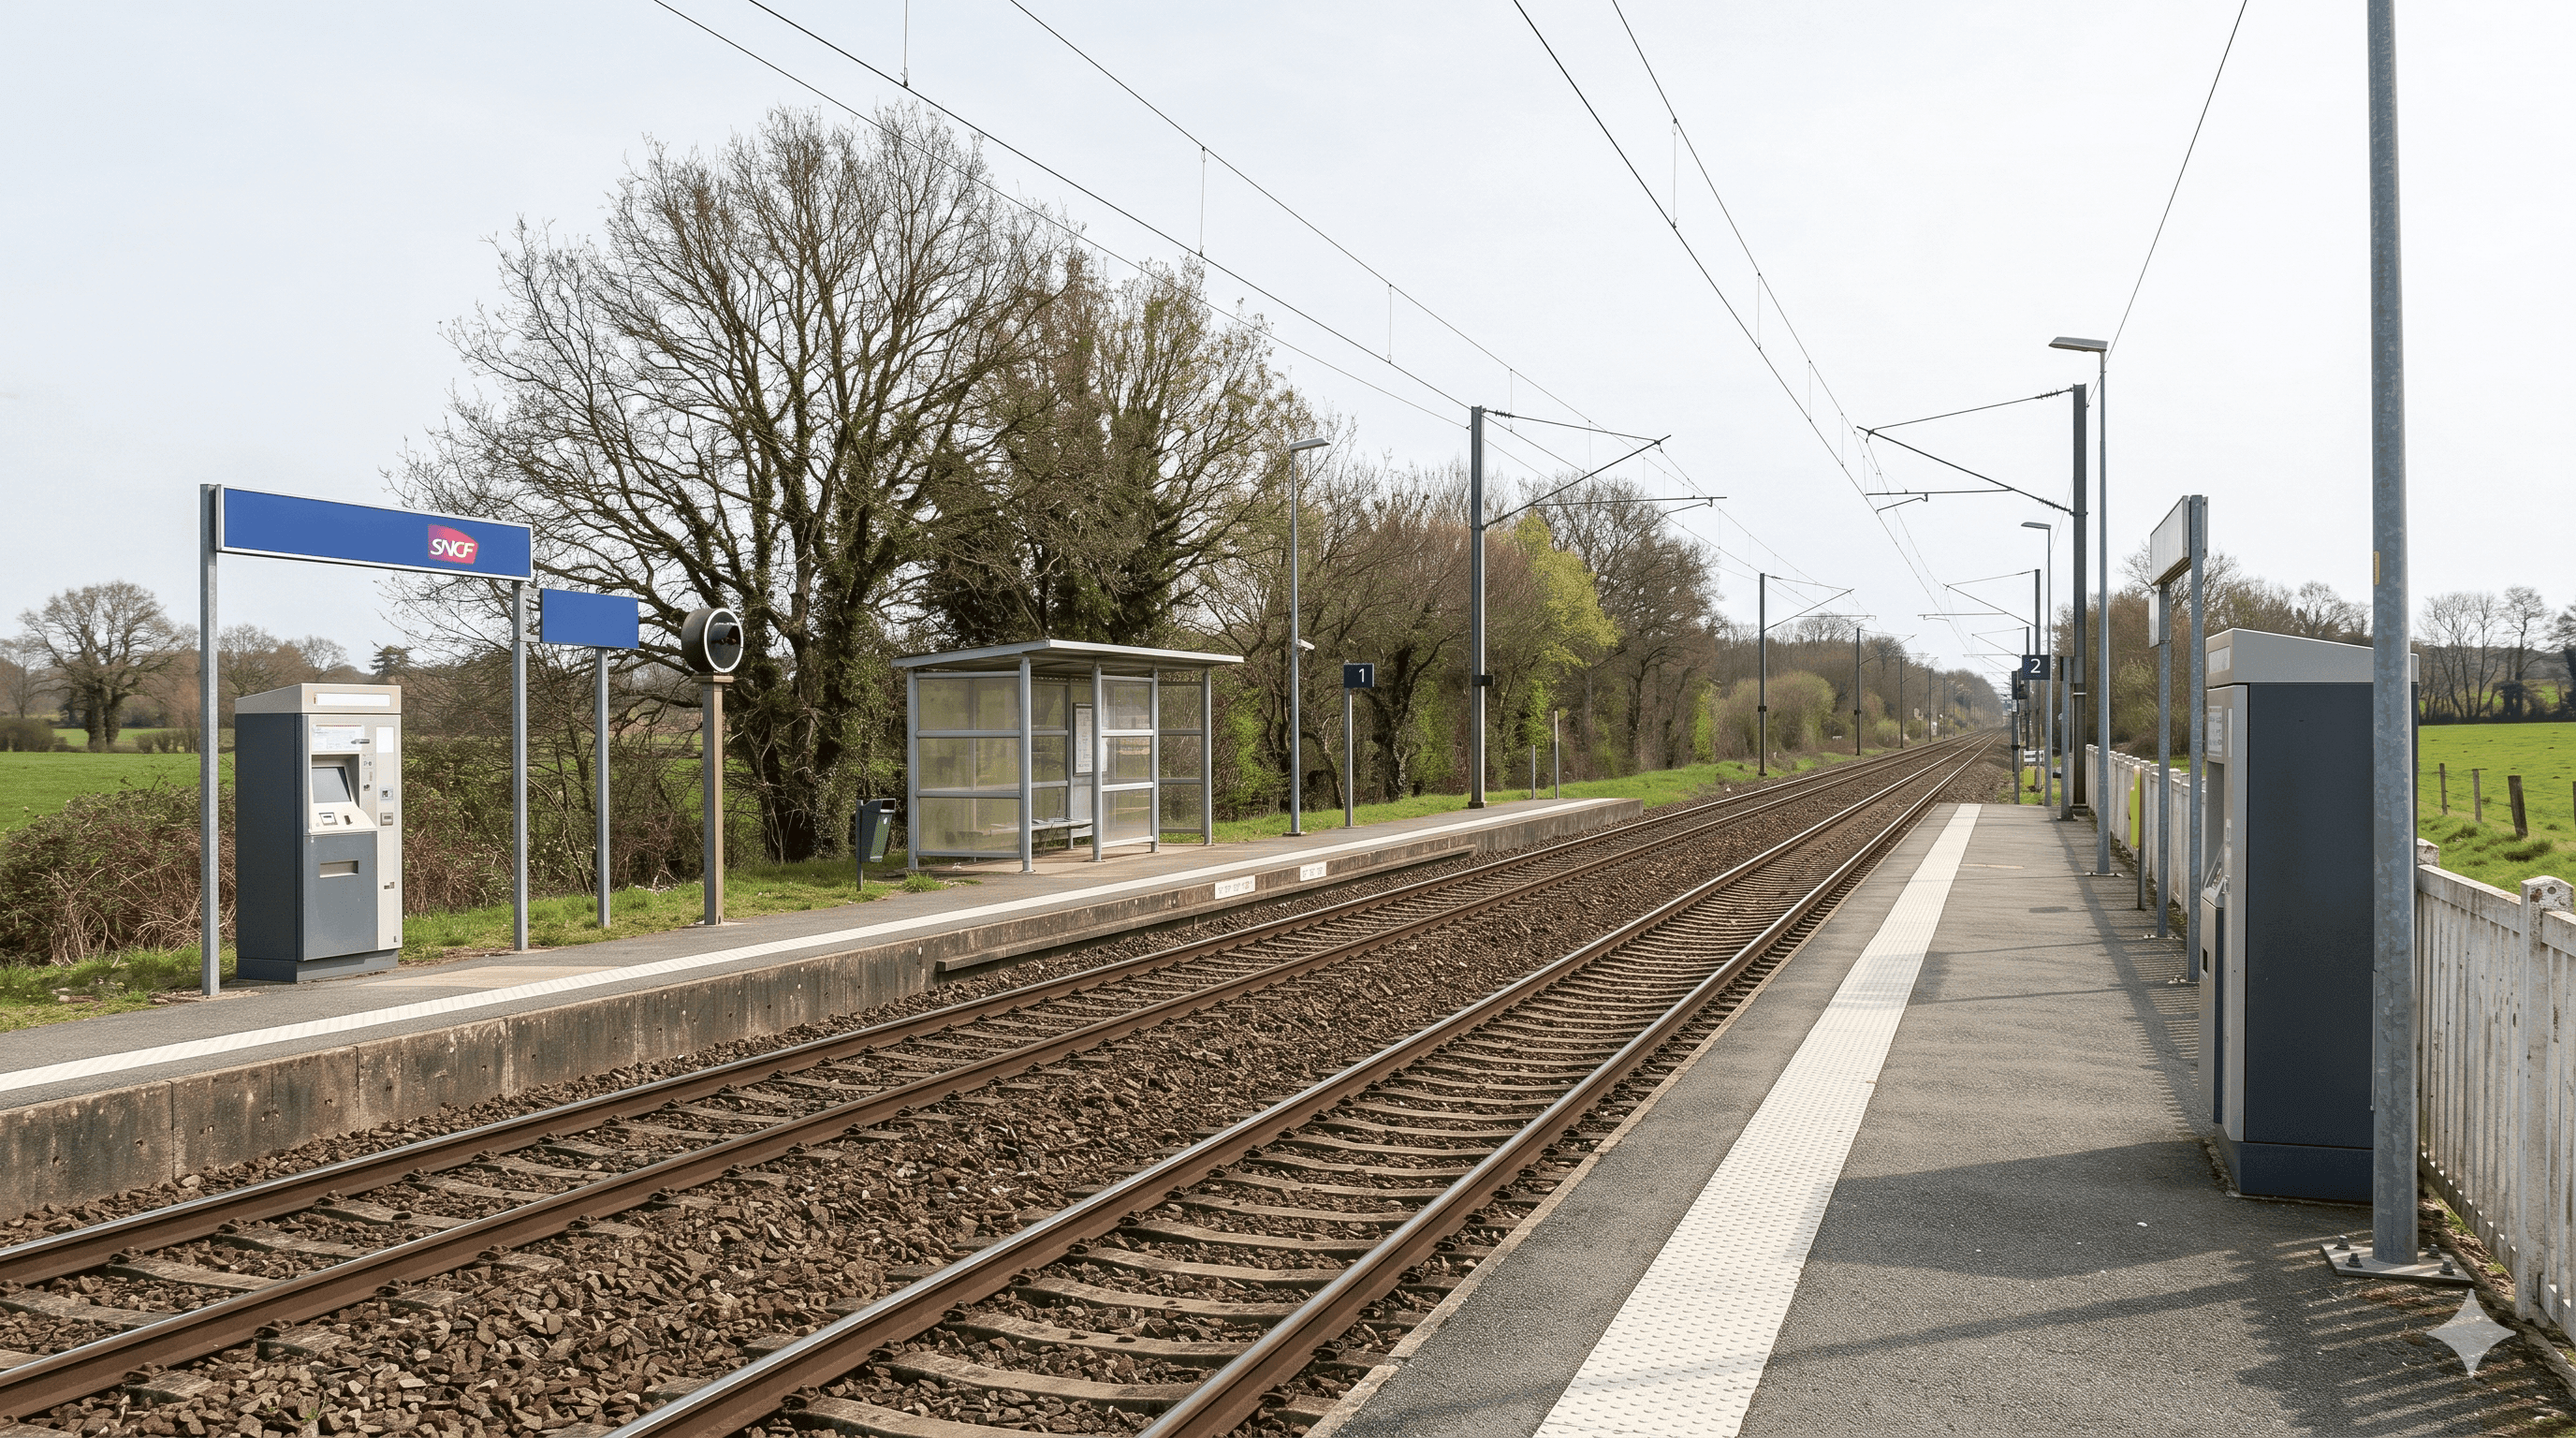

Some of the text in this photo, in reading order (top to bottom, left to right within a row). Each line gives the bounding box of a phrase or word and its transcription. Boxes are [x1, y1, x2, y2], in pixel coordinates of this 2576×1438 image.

[431, 538, 475, 558] SNCF
[2030, 658, 2041, 674] 2
[1358, 668, 1365, 683] 1
